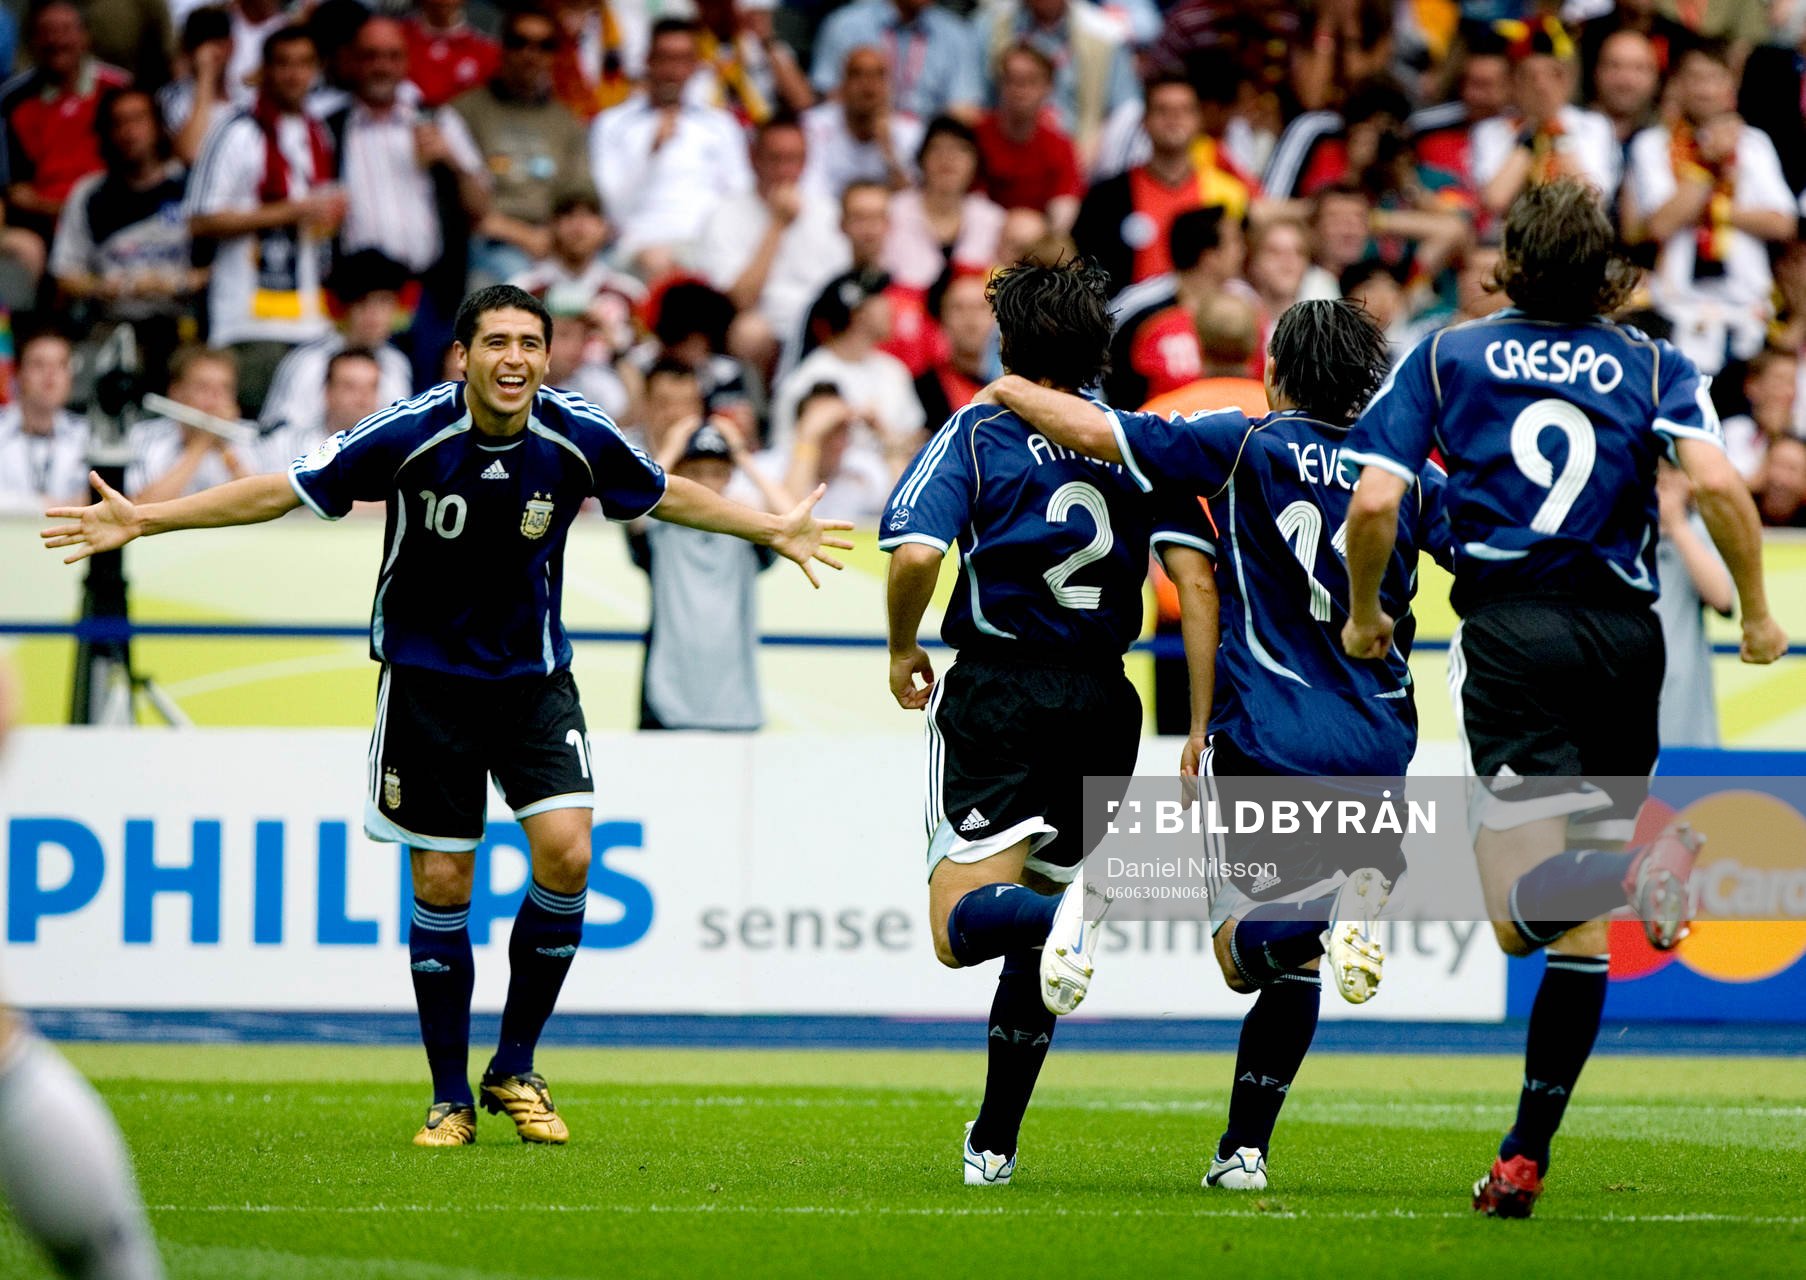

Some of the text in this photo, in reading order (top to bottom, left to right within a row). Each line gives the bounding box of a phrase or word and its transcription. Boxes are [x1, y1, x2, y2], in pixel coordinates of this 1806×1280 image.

[1485, 339, 1624, 394] CRESPO
[480, 471, 510, 480] adidas
[1288, 442, 1361, 492] TEVE
[1510, 398, 1597, 535] 9
[419, 489, 468, 540] 10
[1042, 480, 1114, 610] 2
[1275, 500, 1347, 623] 1
[959, 818, 990, 832] adidas
[699, 906, 915, 950] sense
[989, 1024, 1050, 1047] AFA
[1523, 1072, 1566, 1096] FA
